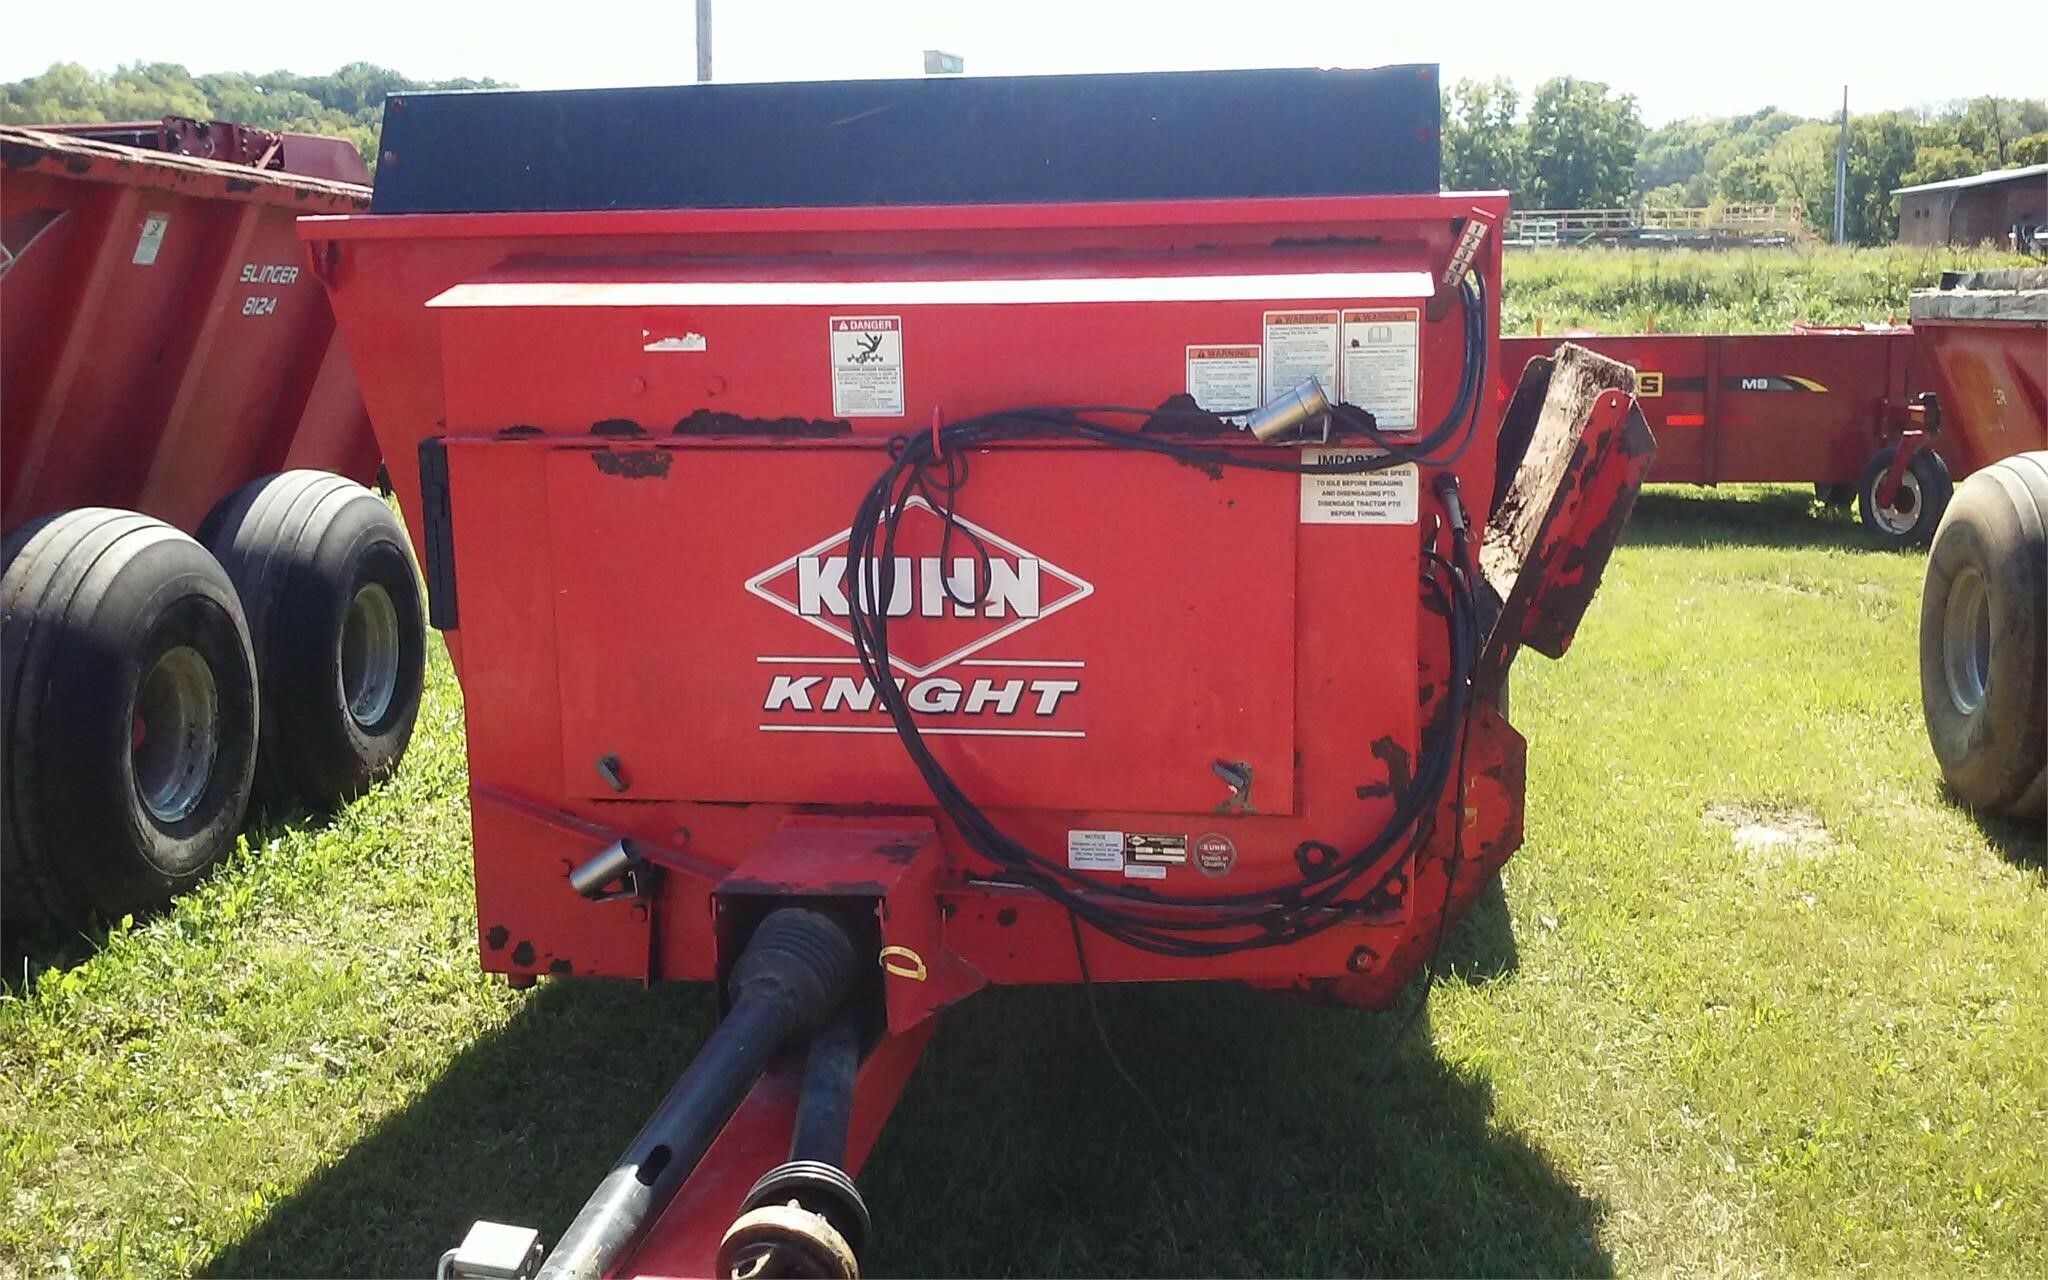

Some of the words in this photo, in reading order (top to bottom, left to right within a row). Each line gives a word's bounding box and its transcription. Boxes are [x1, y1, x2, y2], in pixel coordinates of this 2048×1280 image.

[1466, 236, 1475, 246] 2
[240, 264, 298, 283] SLINGER
[242, 297, 277, 316] 8124
[1286, 314, 1329, 324] WARNING
[1364, 312, 1408, 322] WARNING
[850, 320, 892, 330] DANGER
[1207, 350, 1250, 358] WARNING
[797, 556, 1040, 618] KUHN
[763, 676, 1079, 715] KNGHT
